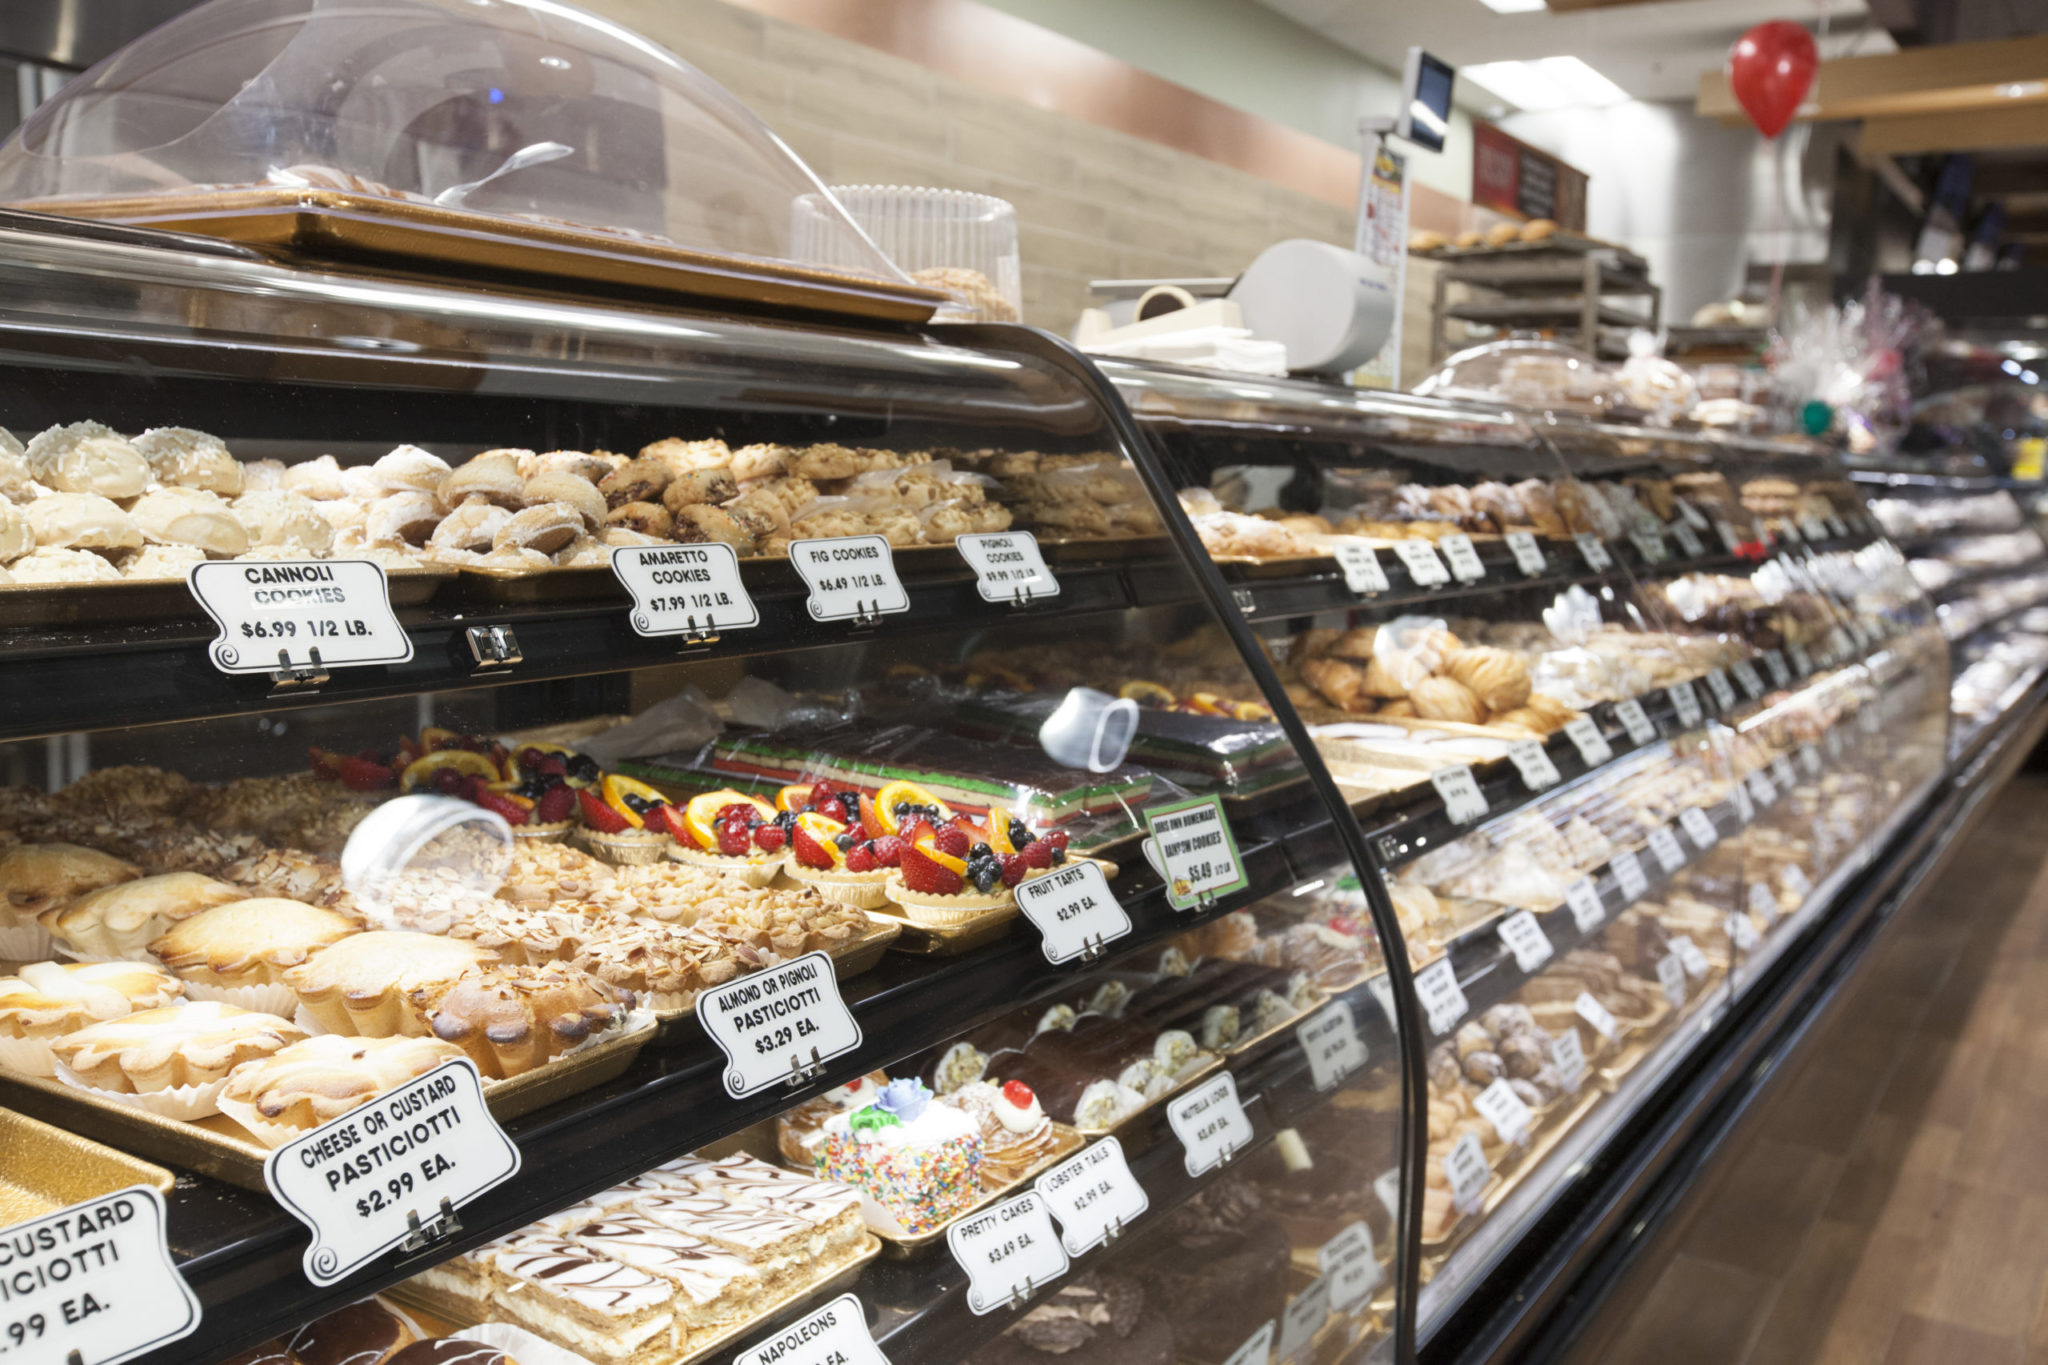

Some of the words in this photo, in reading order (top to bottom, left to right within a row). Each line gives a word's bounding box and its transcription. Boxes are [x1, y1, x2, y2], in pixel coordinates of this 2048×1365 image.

[810, 550, 830, 563] FIG
[832, 546, 879, 561] COOKIES
[980, 538, 1014, 549] PIGNOLI
[639, 550, 708, 566] AMARETTO
[986, 552, 1024, 564] COOKIES
[245, 566, 334, 584] CANNOLI
[652, 568, 711, 584] COOKIES
[852, 576, 869, 588] 1/2
[870, 574, 886, 586] LB.
[650, 596, 686, 612] $7.99
[691, 594, 712, 608] 1/2
[714, 592, 733, 606] LB.
[241, 621, 296, 639] $6.99
[307, 620, 339, 637] 1/2
[345, 620, 373, 636] LB.
[1183, 808, 1216, 828] HOMEMADE
[1192, 830, 1222, 851] COOKIES
[1188, 861, 1212, 883] $5.49
[1028, 880, 1054, 900] FRUIT
[1054, 868, 1084, 888] TARTS
[1056, 902, 1082, 922] $2.99
[718, 984, 762, 1014] ALMOND
[762, 978, 780, 996] OR
[778, 962, 818, 990] PIGNOLI
[733, 986, 822, 1033] PASTICIOTTI
[754, 1026, 793, 1055] $3.29
[796, 1017, 820, 1038] EA.
[300, 1123, 362, 1169] CHEESE
[363, 1110, 389, 1136] OR
[389, 1074, 456, 1122] CUSTARD
[326, 1105, 462, 1193] PASTICIOTTI
[1044, 1161, 1084, 1193] LOBSTER
[1084, 1146, 1110, 1168] TAILS
[356, 1171, 414, 1218] $2.99
[420, 1152, 457, 1182] EA.
[1074, 1188, 1098, 1211] $2.99
[960, 1214, 998, 1241] PRETTY
[1001, 1198, 1034, 1222] CAKES
[0, 1200, 135, 1266] CUSTARD
[988, 1240, 1016, 1264] $3.49
[1017, 1232, 1034, 1250] EA.
[60, 1292, 111, 1325] EA.
[758, 1311, 838, 1365] NAPOLEONS
